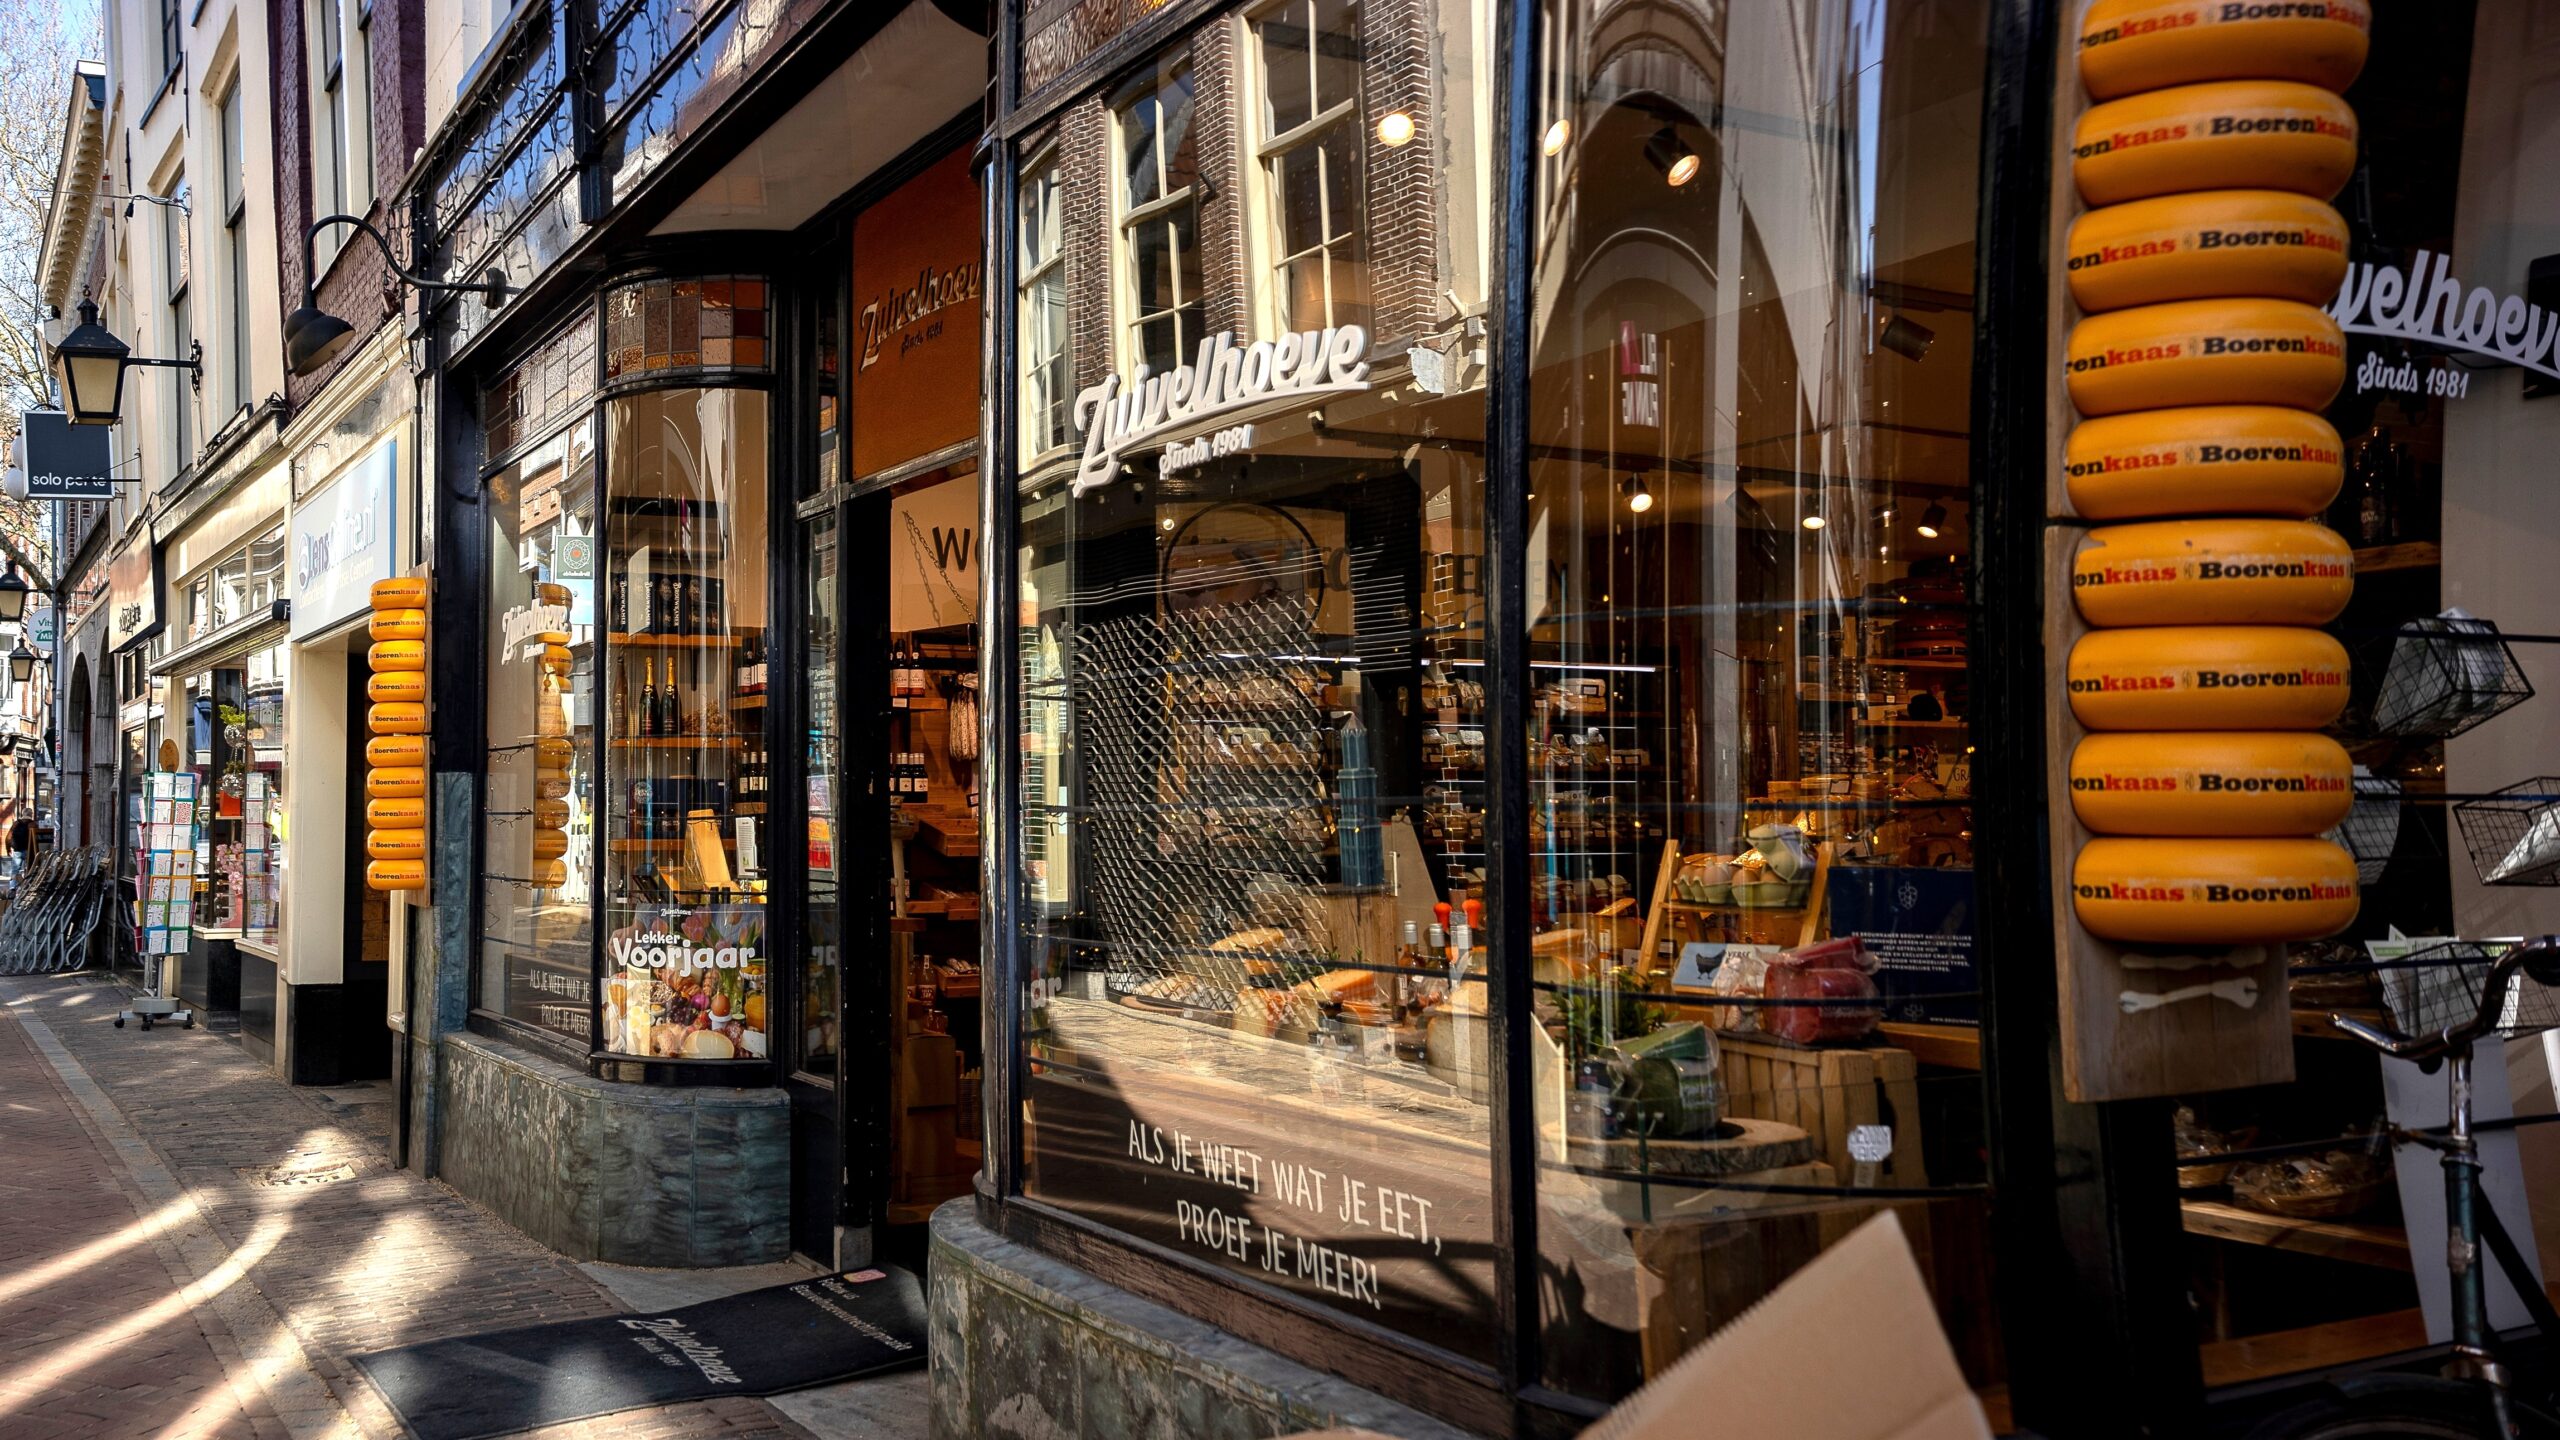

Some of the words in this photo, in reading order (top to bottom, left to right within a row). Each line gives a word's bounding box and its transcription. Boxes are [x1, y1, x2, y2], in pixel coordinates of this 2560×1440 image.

[2220, 1, 2365, 29] Boerenkaas
[2210, 115, 2352, 141] Boerenkaas
[2198, 229, 2343, 253] Boerenkaas
[2321, 249, 2560, 379] velhoev
[2203, 336, 2341, 358] Boerenkaas
[2357, 351, 2418, 394] Sinds
[2426, 368, 2469, 399] 1981
[1072, 325, 1373, 499] Zuivelhoeve
[1159, 436, 1213, 481] Sinds
[1212, 424, 1255, 457] 1981
[2199, 444, 2338, 465] Boerenkaas
[32, 472, 62, 486] solo
[932, 526, 978, 573] W
[2199, 560, 2345, 579] Boerenkaas
[2067, 674, 2175, 692] enkaas
[2197, 669, 2341, 689] Boerenkaas
[2070, 774, 2177, 792] enkaas
[2199, 774, 2345, 793] Boerenkaas
[2207, 884, 2350, 903] Boerenkaas
[635, 930, 681, 944] Lekker
[613, 937, 755, 977] Voorjaar
[529, 968, 540, 991] ALS
[582, 980, 590, 1002] JE
[1129, 1119, 1164, 1165] ALS
[1171, 1130, 1195, 1175] JE
[1200, 1140, 1262, 1194] WEET
[1271, 1159, 1326, 1214] WAT
[1339, 1174, 1370, 1227] JE
[1377, 1186, 1441, 1256] EET,
[1177, 1199, 1251, 1263] PROEF
[1261, 1226, 1289, 1276] JE
[1297, 1237, 1382, 1310] MEER!
